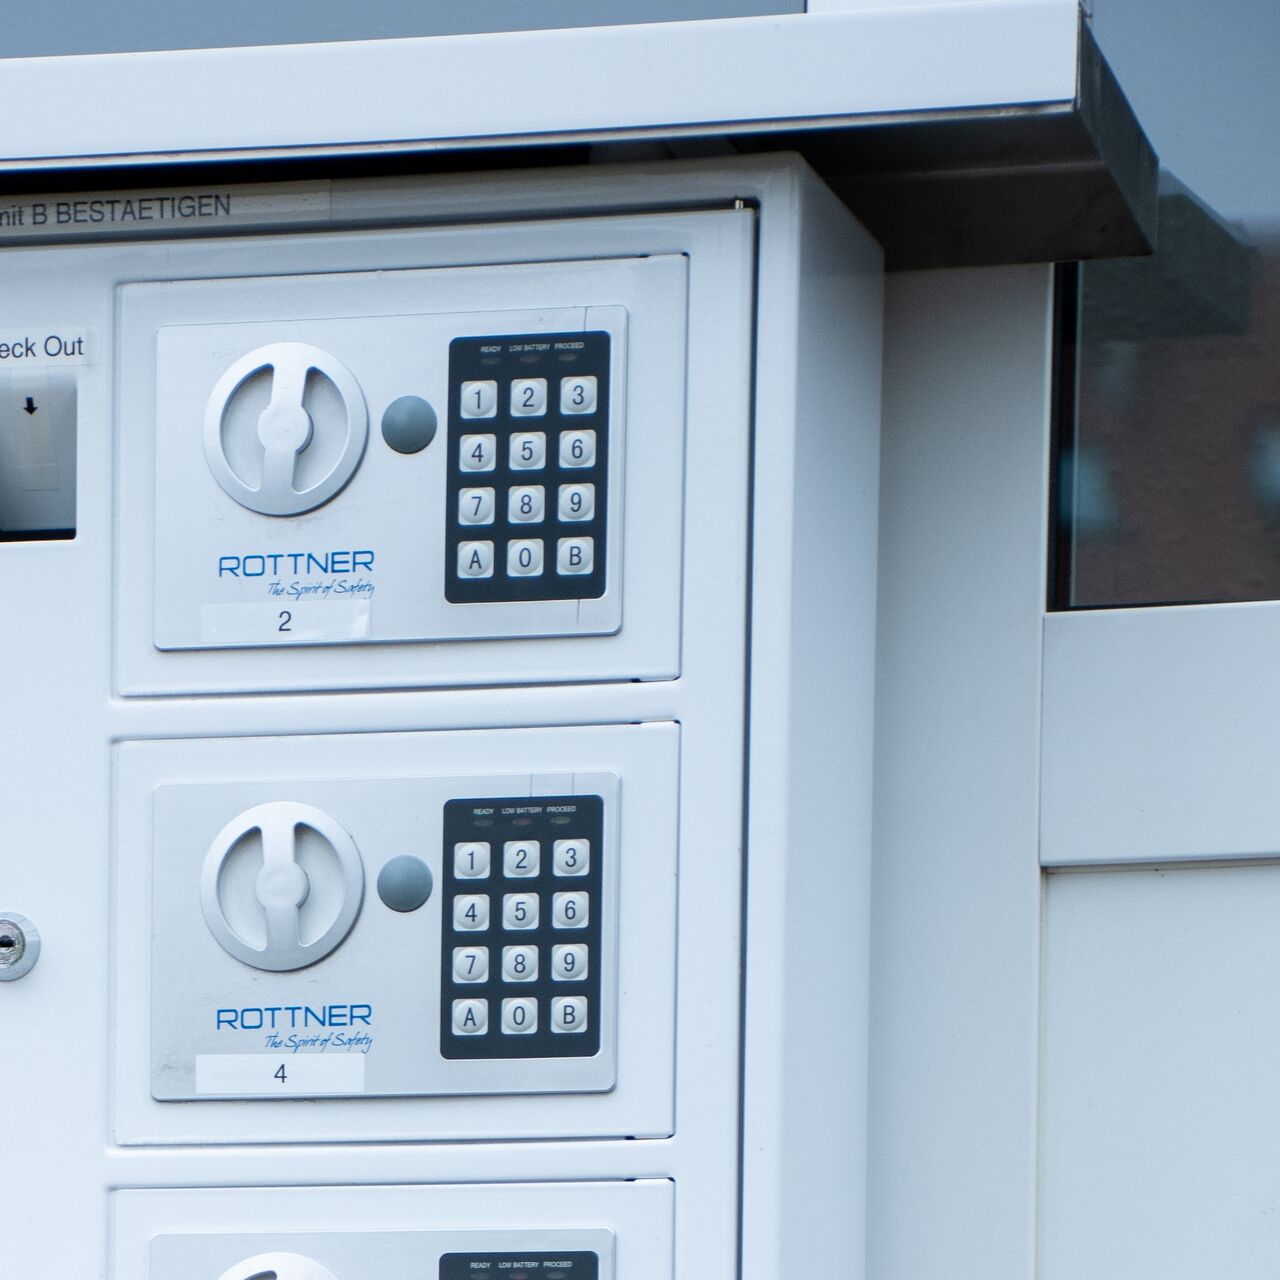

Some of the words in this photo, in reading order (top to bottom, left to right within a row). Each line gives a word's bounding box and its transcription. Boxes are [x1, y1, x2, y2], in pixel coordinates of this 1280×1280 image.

[32, 203, 48, 225] B
[56, 194, 231, 224] BESTAETIGEN
[44, 335, 84, 357] Out
[219, 550, 374, 577] ROTTNER
[268, 580, 285, 595] The
[287, 581, 324, 600] Spirit
[322, 579, 334, 599] of
[334, 579, 375, 599] Safety
[279, 611, 292, 631] 2
[515, 849, 529, 870] 2
[565, 847, 578, 869] 3
[464, 903, 479, 924] 4
[514, 901, 528, 923] 5
[564, 900, 577, 921] 6
[465, 955, 477, 976] 7
[513, 953, 527, 975] 8
[563, 952, 577, 974] 9
[217, 1004, 371, 1030] ROTTNER
[463, 1007, 478, 1028] A
[512, 1005, 527, 1027] 0
[563, 1004, 577, 1026] B
[265, 1032, 282, 1048] The
[285, 1034, 321, 1054] Spirit
[320, 1032, 333, 1052] of
[332, 1031, 372, 1053] Safety
[274, 1064, 287, 1083] 4
